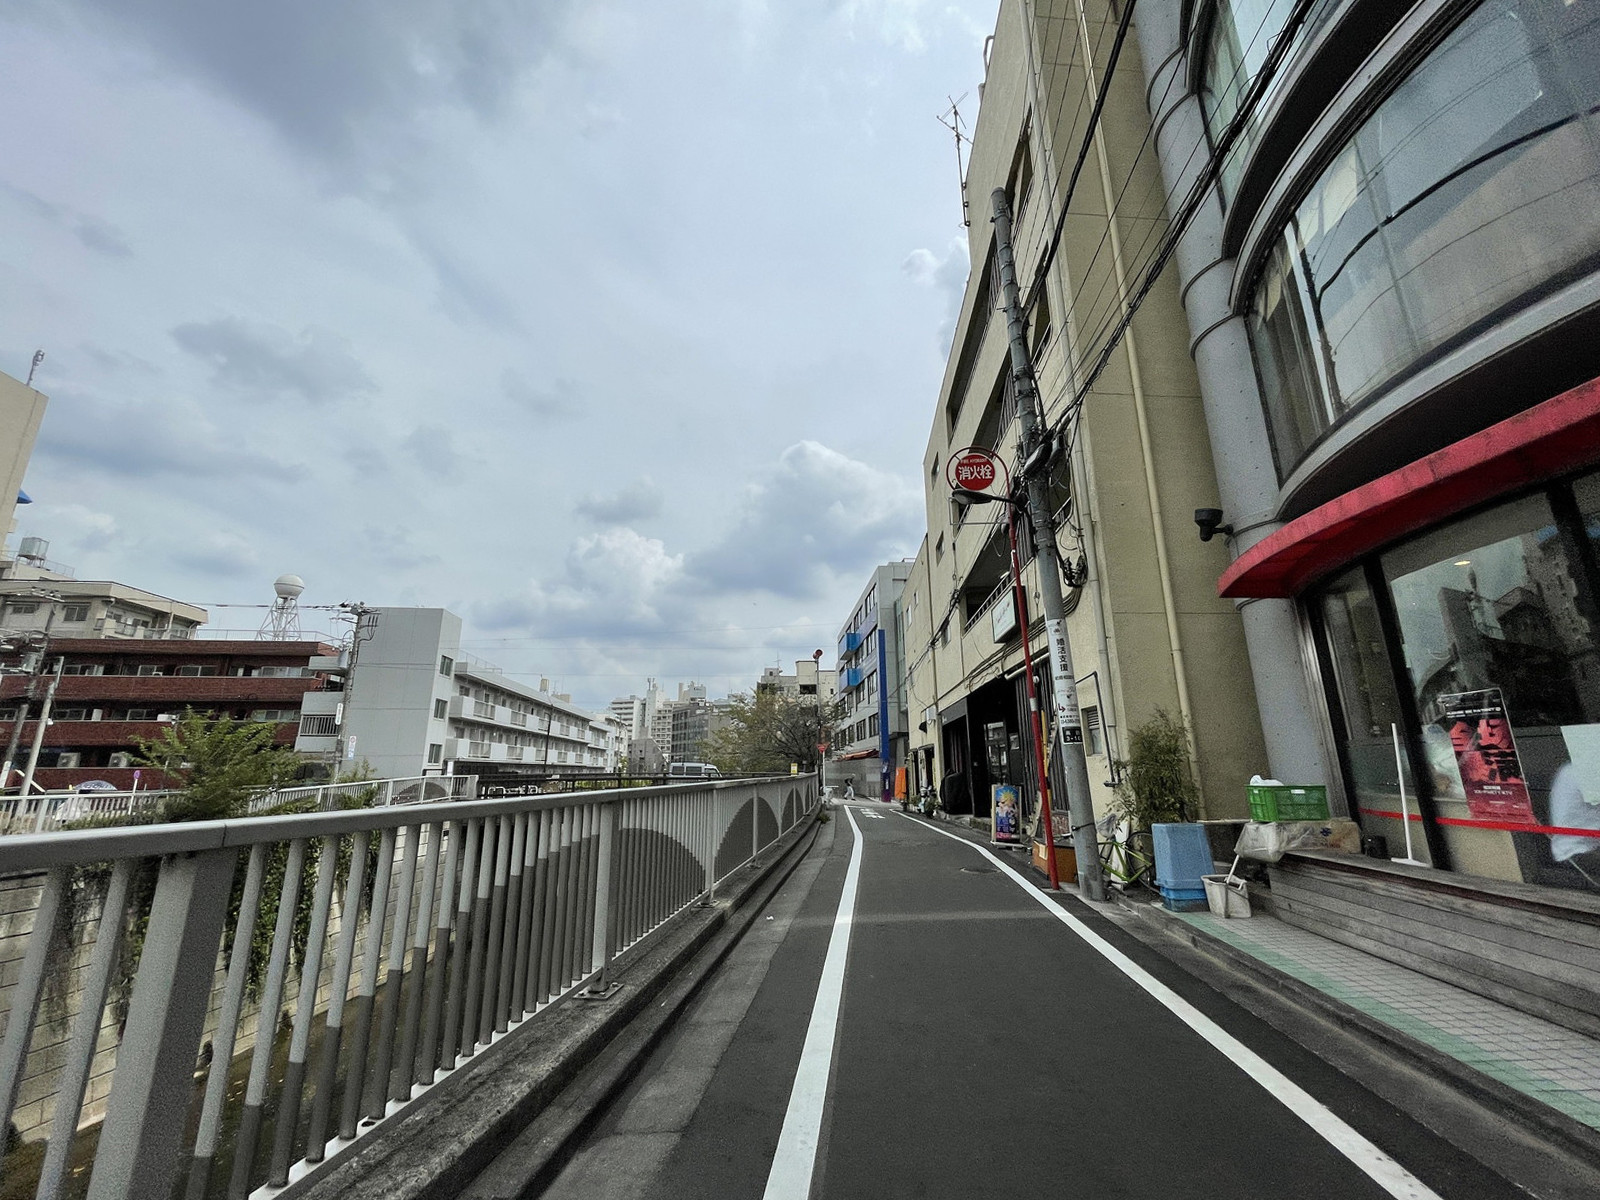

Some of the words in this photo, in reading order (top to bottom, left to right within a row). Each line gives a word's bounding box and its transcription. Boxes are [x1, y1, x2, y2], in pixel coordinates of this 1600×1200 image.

[958, 464, 993, 481] 消火栓
[1056, 638, 1068, 671] 婚活支援
